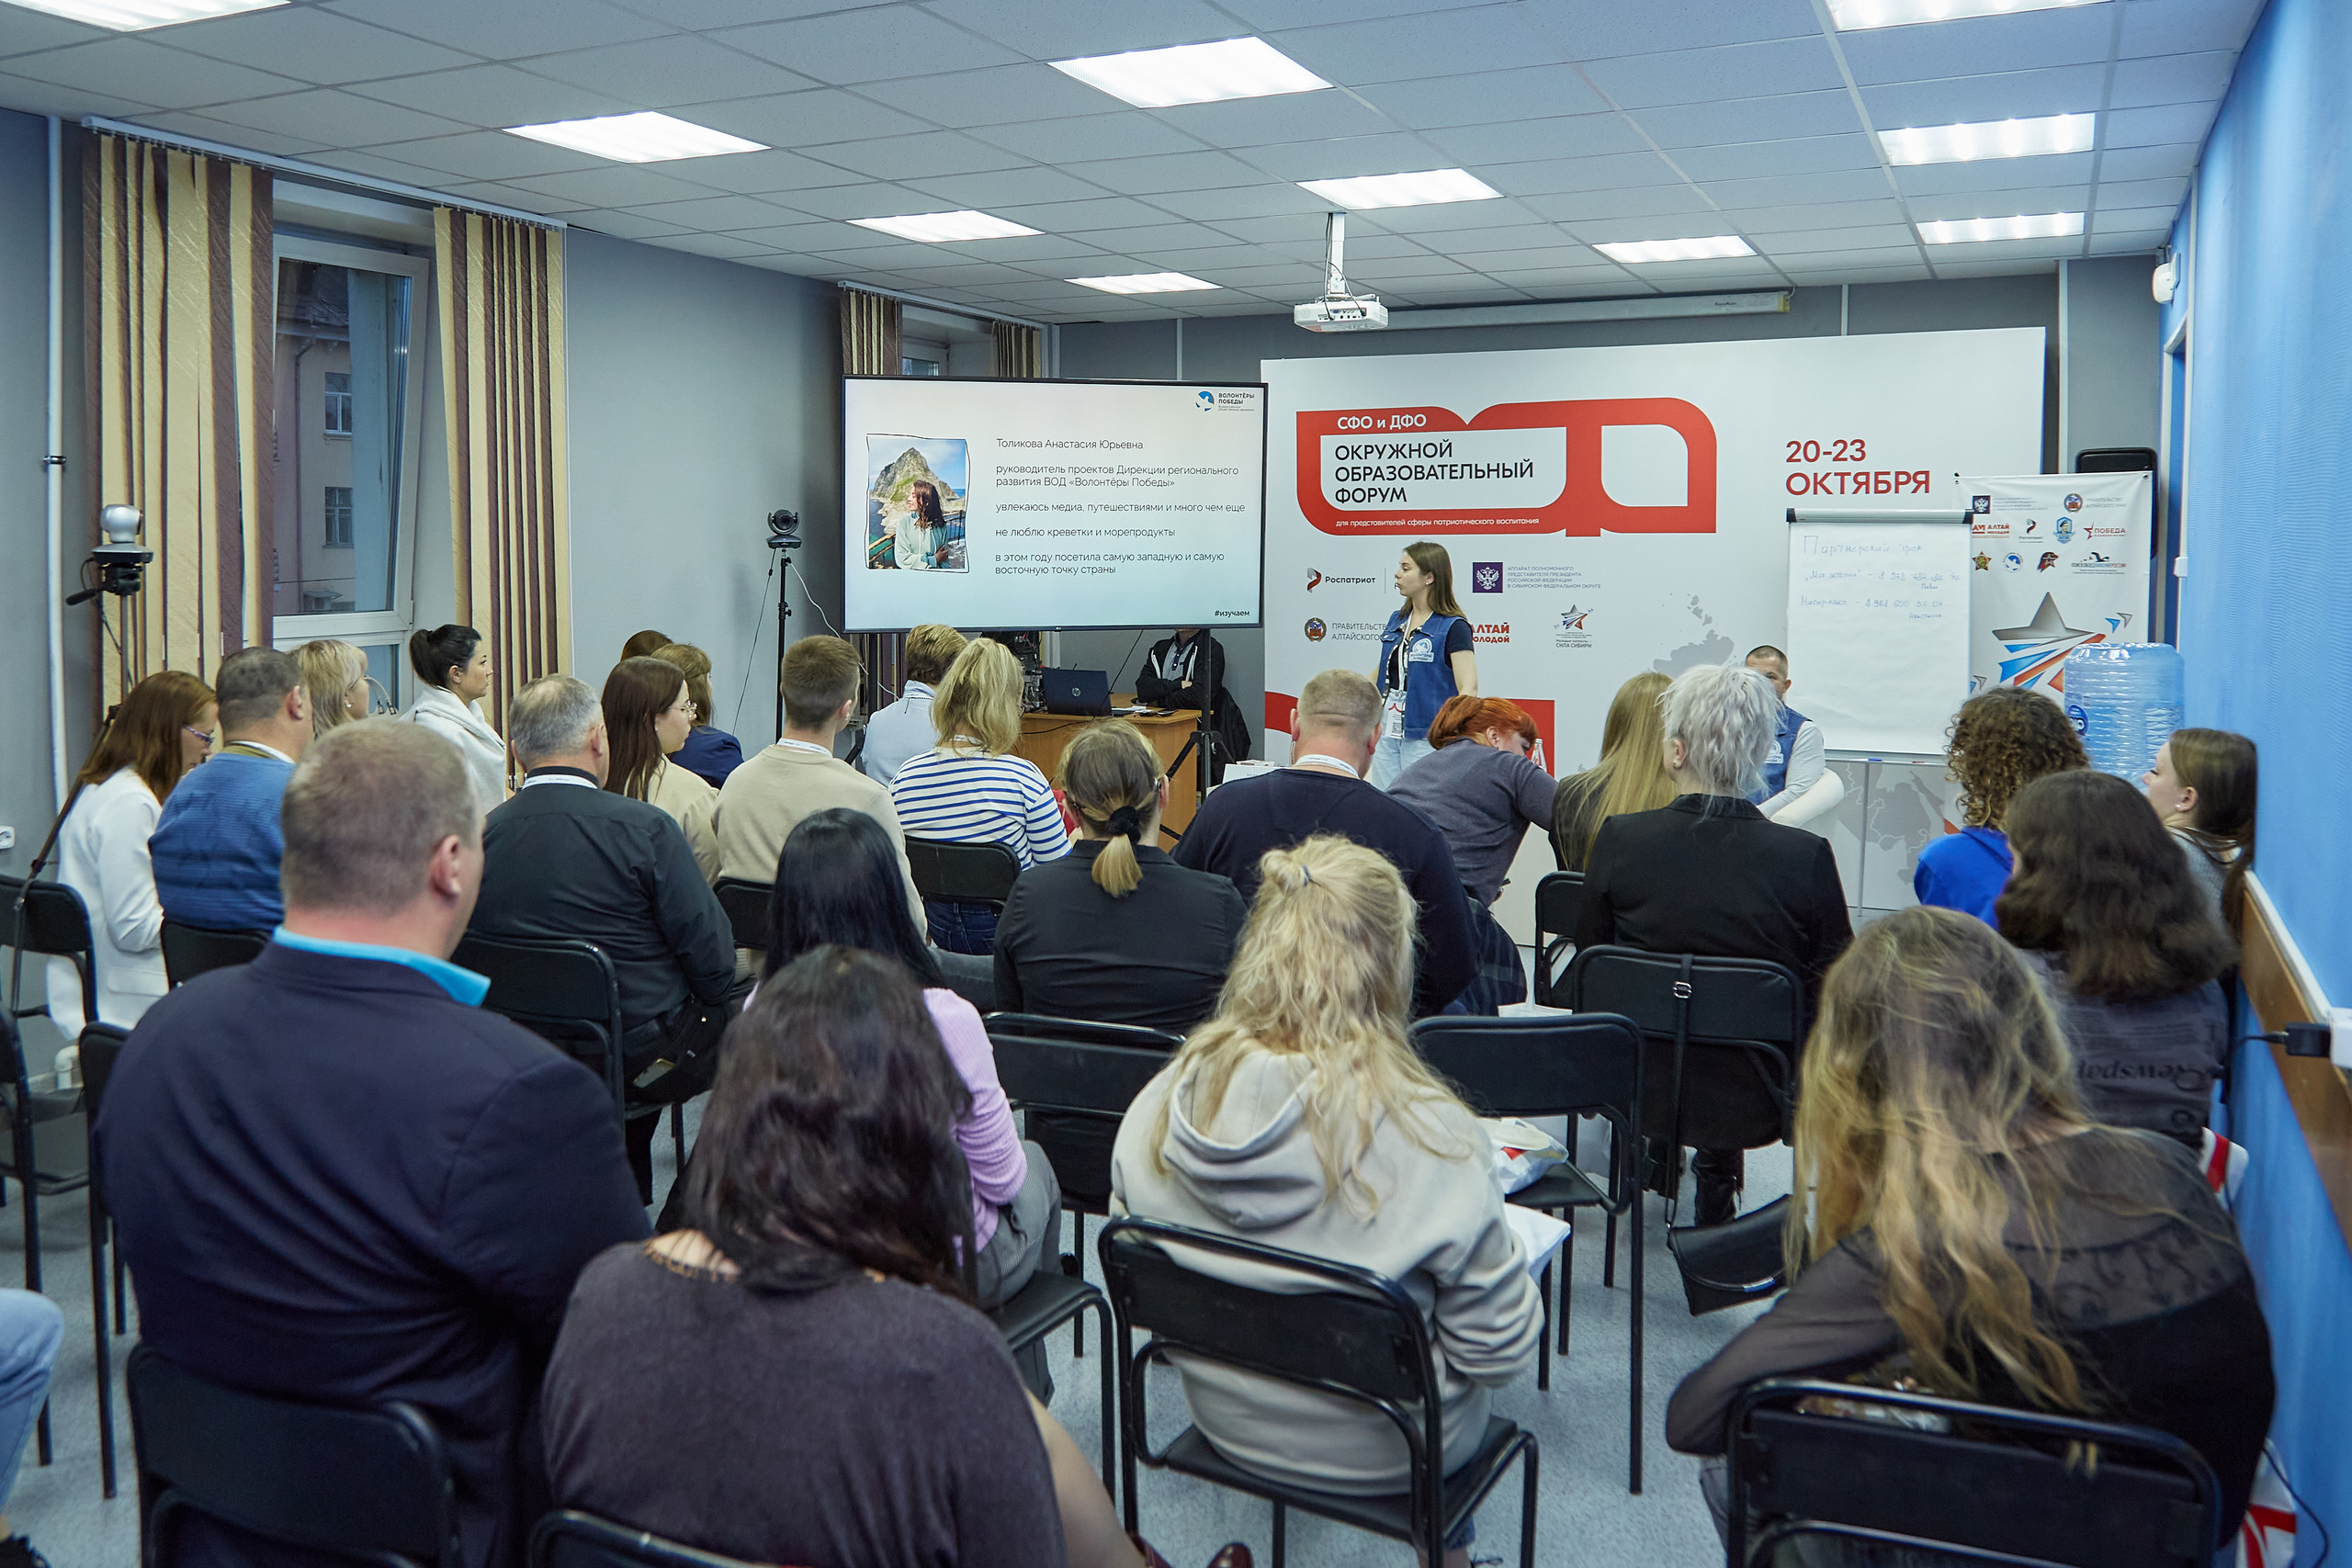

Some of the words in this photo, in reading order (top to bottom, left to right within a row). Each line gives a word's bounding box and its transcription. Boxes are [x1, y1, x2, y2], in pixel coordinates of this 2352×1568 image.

[1337, 415, 1374, 430] СФО
[1376, 418, 1386, 428] и
[1389, 413, 1427, 430] ДФО
[996, 438, 1043, 448] Толикова
[1045, 439, 1097, 449] Анастасия
[1099, 440, 1144, 450] Юрьевна
[1335, 439, 1453, 461] ОКРУЖНОЙ
[1786, 439, 1867, 463] 20-23
[996, 465, 1066, 475] руководитель
[1068, 466, 1114, 476] проектов
[1116, 465, 1166, 476] Дирекции
[1168, 467, 1239, 477] регионального
[1335, 458, 1533, 482] ОБРАЗОВАТЕЛЬНЫЙ
[996, 478, 1041, 488] развития
[1044, 477, 1067, 487] ВОД
[1069, 477, 1130, 488] «Волонтёры
[1132, 478, 1175, 488] Победы»
[1786, 470, 1930, 496] ОКТЯБРЯ
[1335, 487, 1408, 504] ФОРУМ
[995, 503, 1049, 513] увлекаюсь
[1051, 503, 1085, 513] медиа,
[1087, 503, 1163, 513] путешествиями
[1225, 504, 1246, 513] еще
[1336, 519, 1349, 527] для
[1350, 518, 1406, 527] представителей
[1407, 518, 1431, 527] сферы
[1433, 518, 1495, 526] патриотического
[1496, 517, 1540, 525] воспитания
[1010, 527, 1046, 536] люблю
[1047, 529, 1093, 538] креветки
[1103, 529, 1176, 538] морепродукты
[995, 554, 1001, 562] в
[1003, 554, 1028, 562] этом
[1030, 554, 1053, 563] году
[1055, 554, 1101, 562] посетила
[1102, 553, 1136, 563] самую
[1136, 553, 1183, 562] западную
[1185, 553, 1192, 561] и
[1193, 553, 1225, 562] самую
[995, 567, 1049, 577] восточную
[1051, 567, 1080, 576] точку
[1080, 566, 1116, 576] страны
[1878, 571, 1885, 581] 8
[1325, 576, 1375, 584] Роспатриот
[1865, 599, 1871, 607] 8
[1215, 610, 1250, 618] #изучаем
[1331, 632, 1380, 640] АЛТАЙСКОГО
[1472, 636, 1510, 644] ОЛОДОЙ
